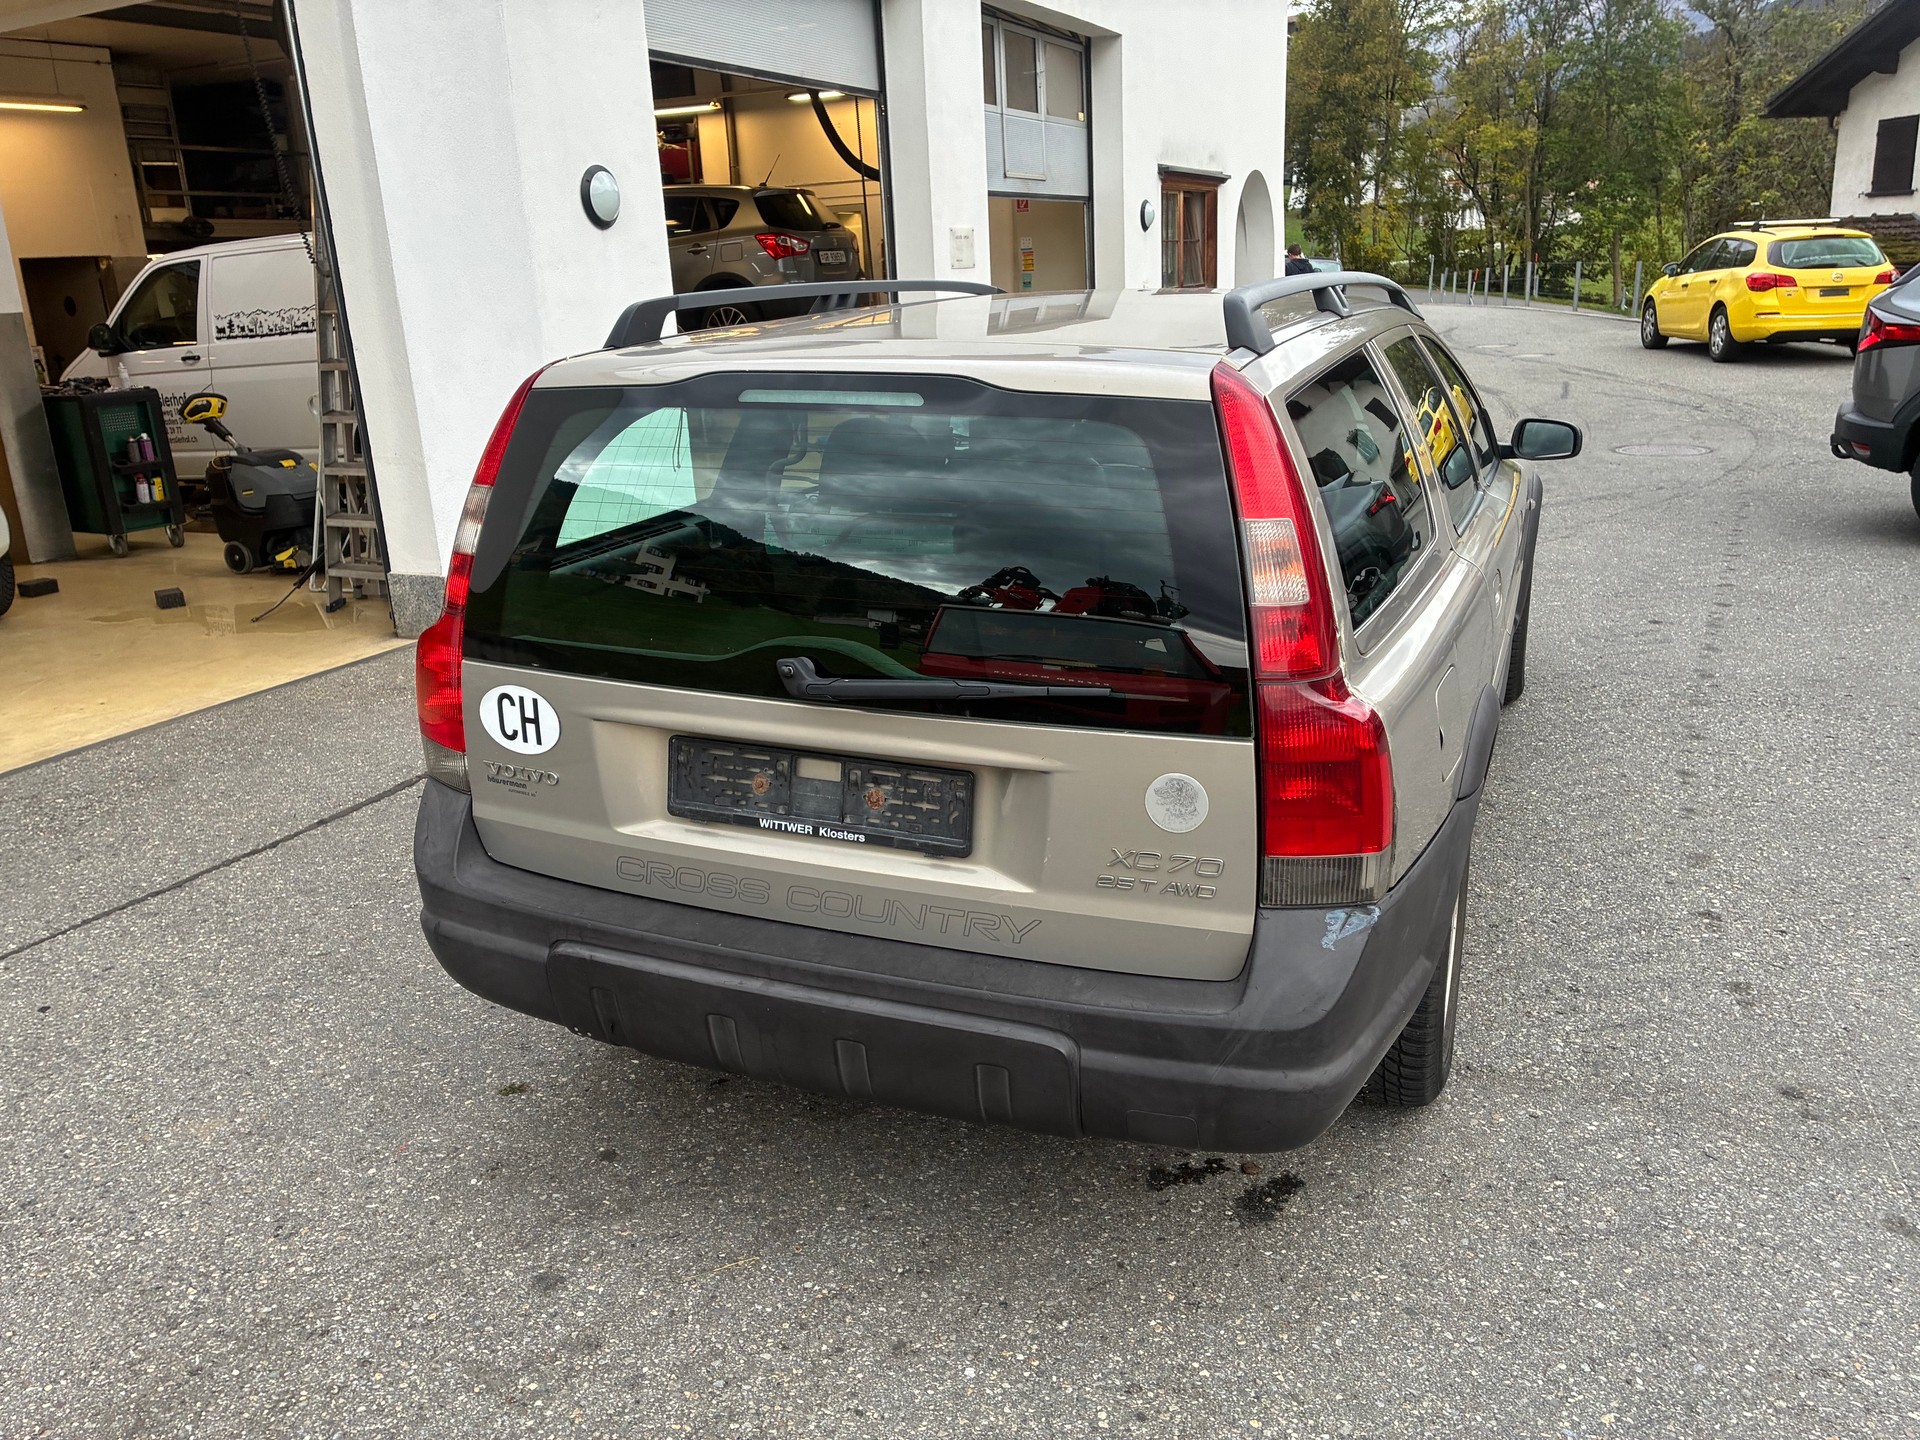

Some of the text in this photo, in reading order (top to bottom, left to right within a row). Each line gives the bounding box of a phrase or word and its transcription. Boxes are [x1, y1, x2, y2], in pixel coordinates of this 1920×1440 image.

[497, 692, 543, 746] CH
[482, 759, 559, 786] VOLVO
[759, 818, 866, 843] WITTWER Klosters
[1106, 847, 1223, 878] XC 70
[616, 855, 1043, 945] CROSS COUNTRY
[1161, 881, 1217, 898] AWD
